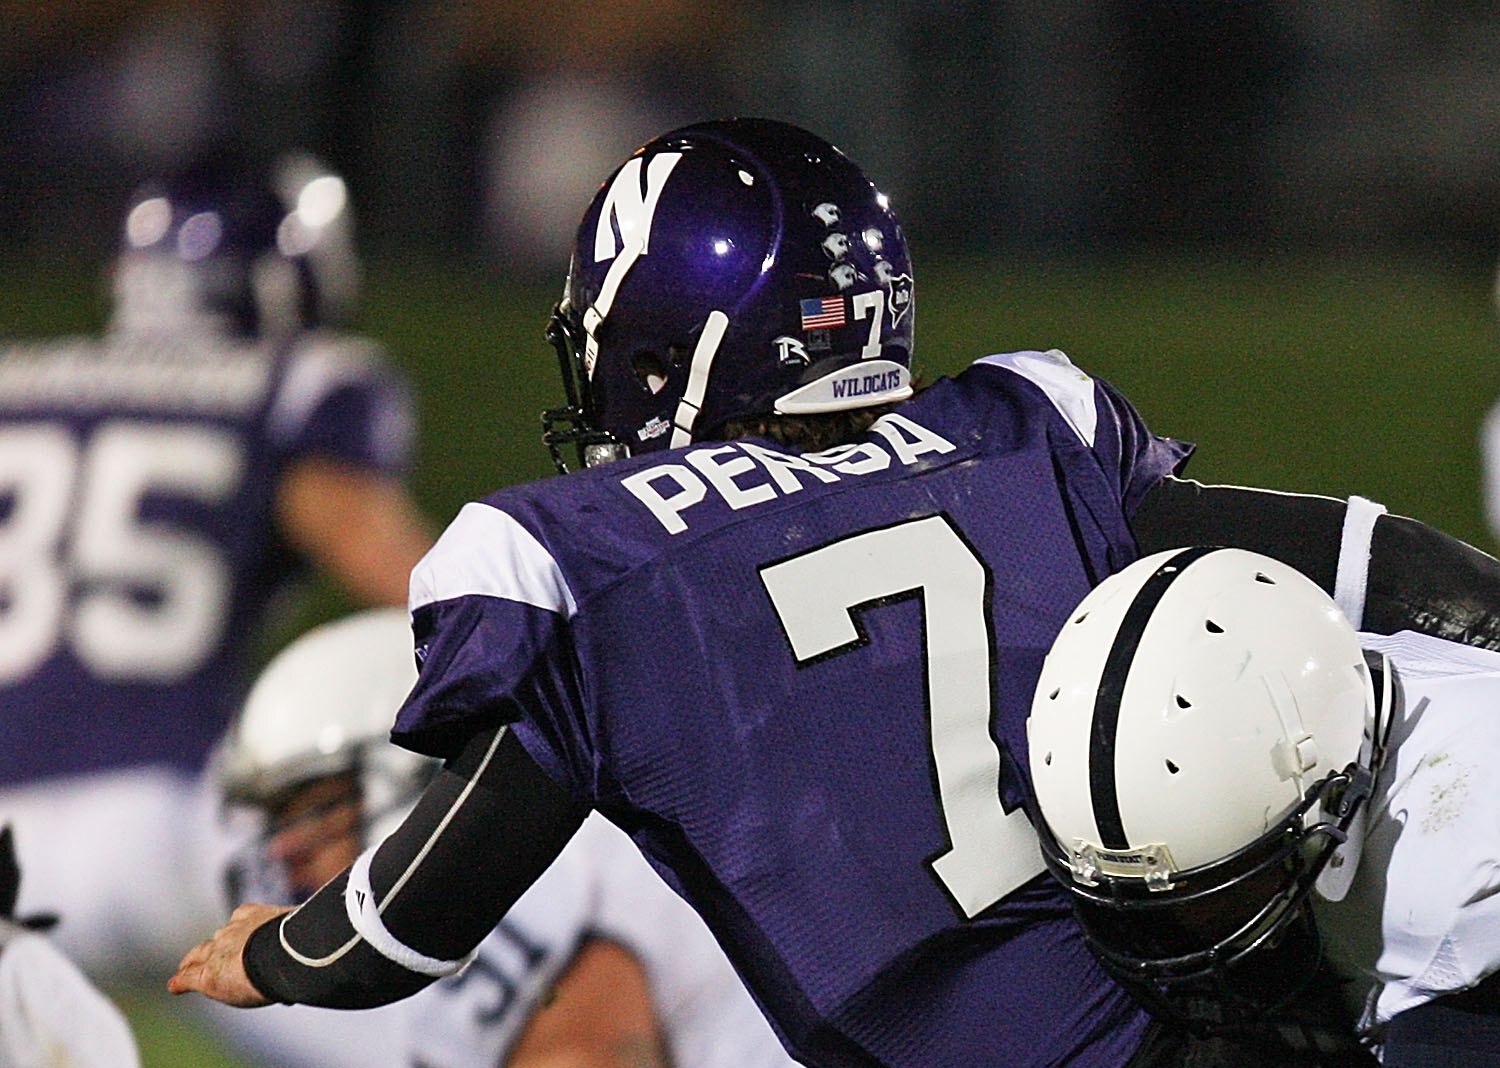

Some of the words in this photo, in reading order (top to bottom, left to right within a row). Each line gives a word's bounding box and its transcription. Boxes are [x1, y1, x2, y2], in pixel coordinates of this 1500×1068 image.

[853, 290, 884, 359] 7
[832, 370, 901, 398] WILDCATS
[620, 412, 957, 536] PERSA
[760, 514, 1046, 919] 7
